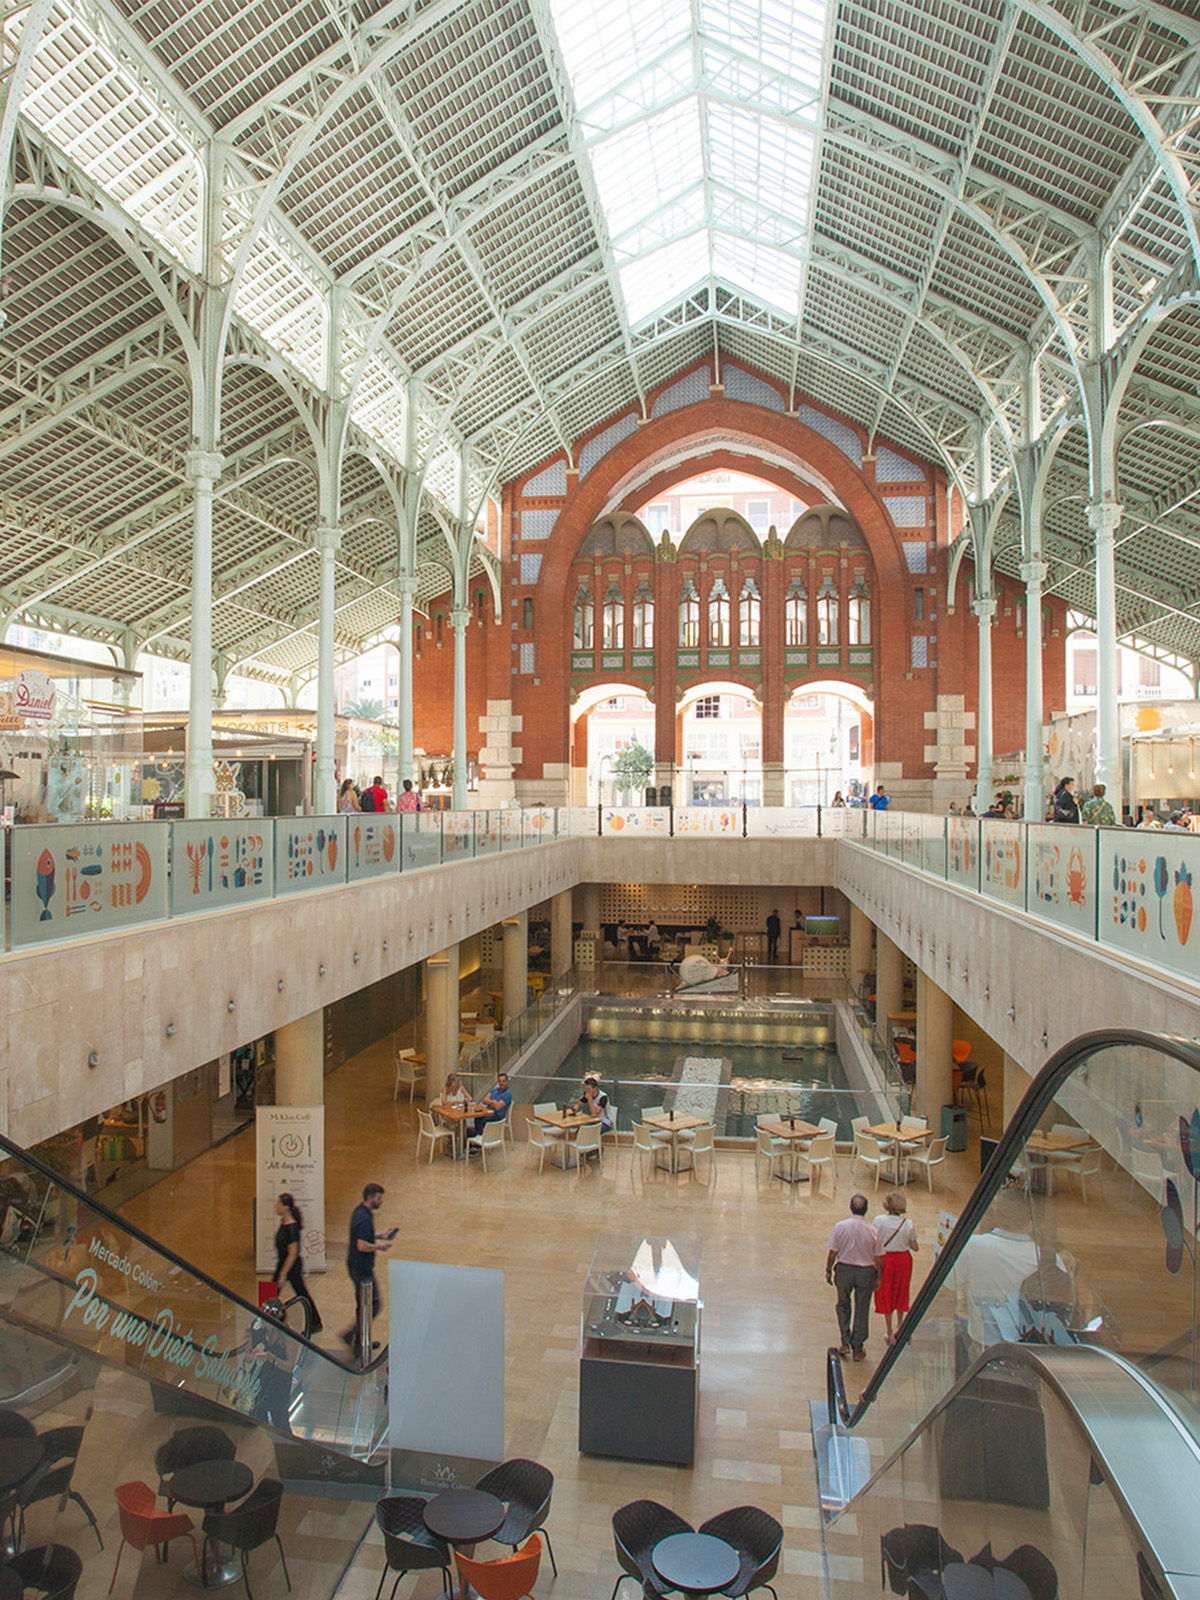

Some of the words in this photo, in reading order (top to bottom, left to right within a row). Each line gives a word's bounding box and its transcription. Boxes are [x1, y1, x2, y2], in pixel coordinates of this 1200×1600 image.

[14, 684, 55, 710] Daniel
[88, 1236, 132, 1277] Mercado
[131, 1263, 159, 1293] Colón
[63, 1268, 111, 1331] Por
[110, 1310, 150, 1348] una
[147, 1308, 195, 1367] Dieta
[194, 1334, 263, 1399] Saludable
